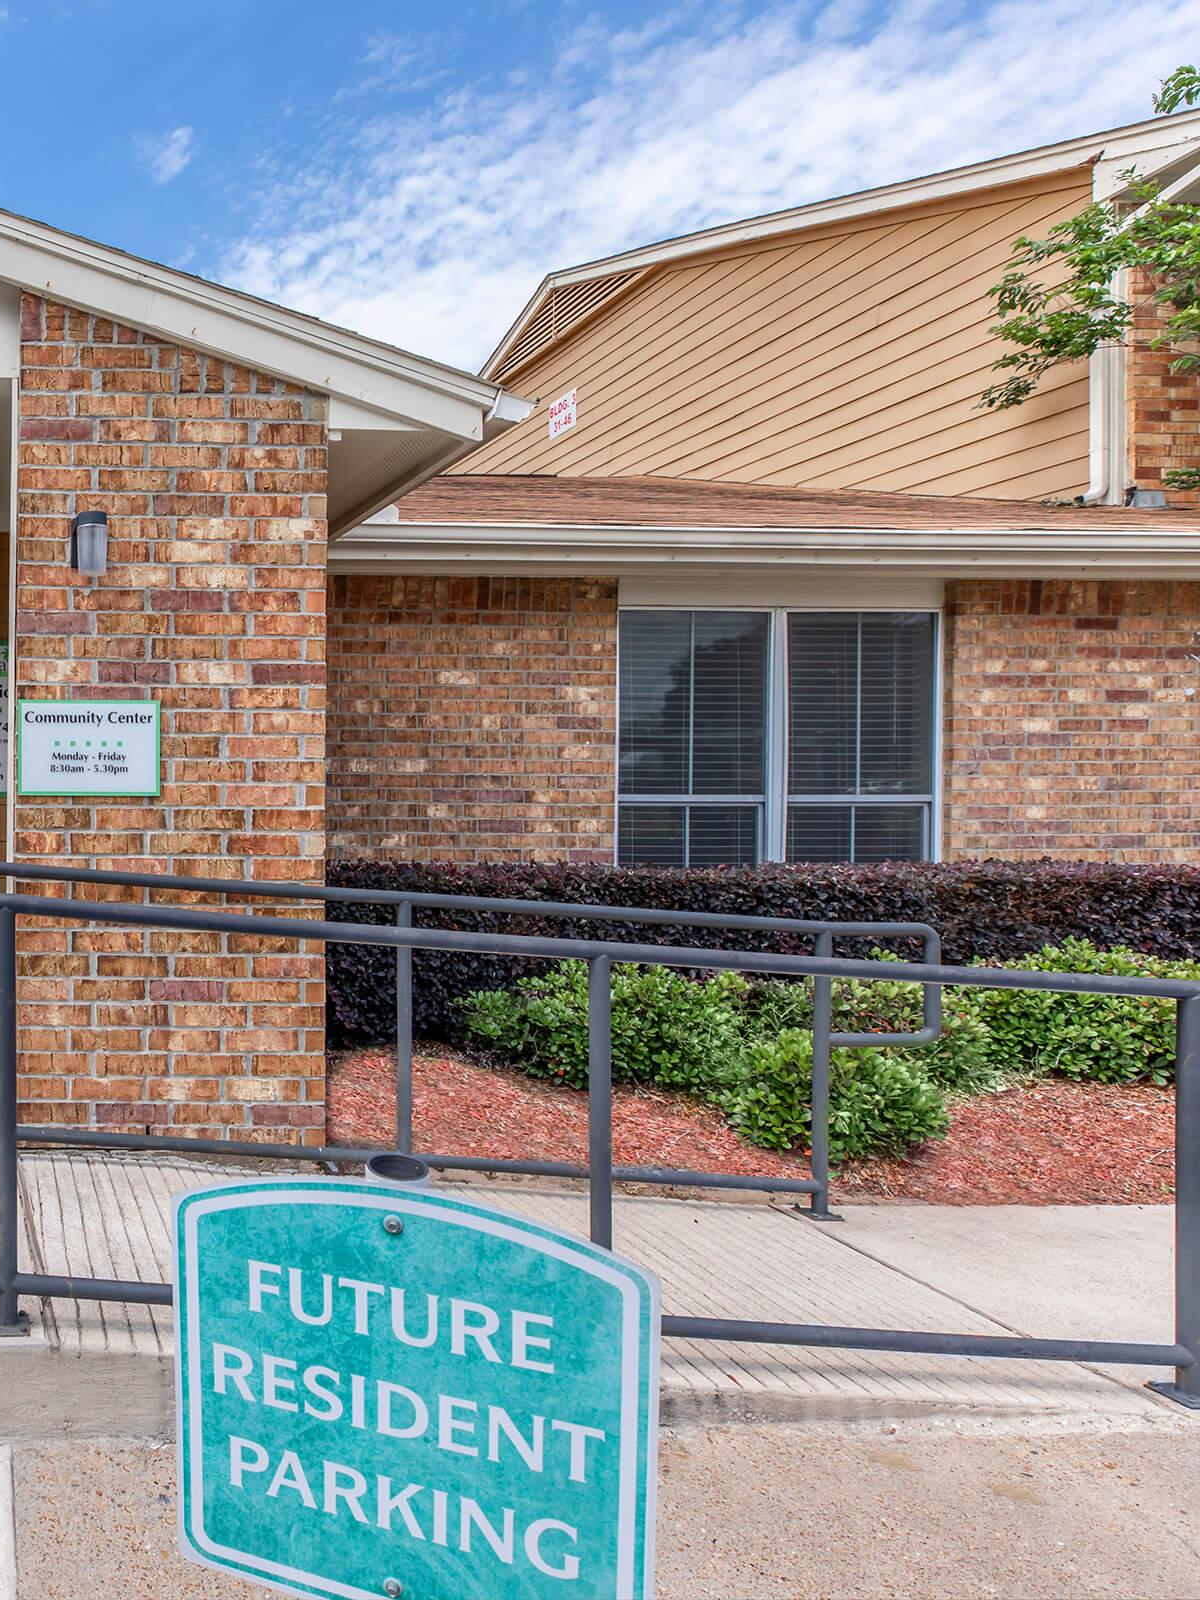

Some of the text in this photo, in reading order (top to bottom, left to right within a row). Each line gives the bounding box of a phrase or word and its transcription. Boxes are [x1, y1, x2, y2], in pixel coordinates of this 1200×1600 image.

[571, 393, 576, 405] 3
[553, 413, 572, 432] 31-46
[24, 711, 153, 727] Community Center
[52, 752, 89, 762] Monday
[98, 752, 127, 762] Friday
[50, 764, 85, 773] 8:30am
[247, 1259, 555, 1374] FUTURE
[211, 1342, 606, 1484] RESIDENT
[229, 1435, 581, 1580] PARKING
